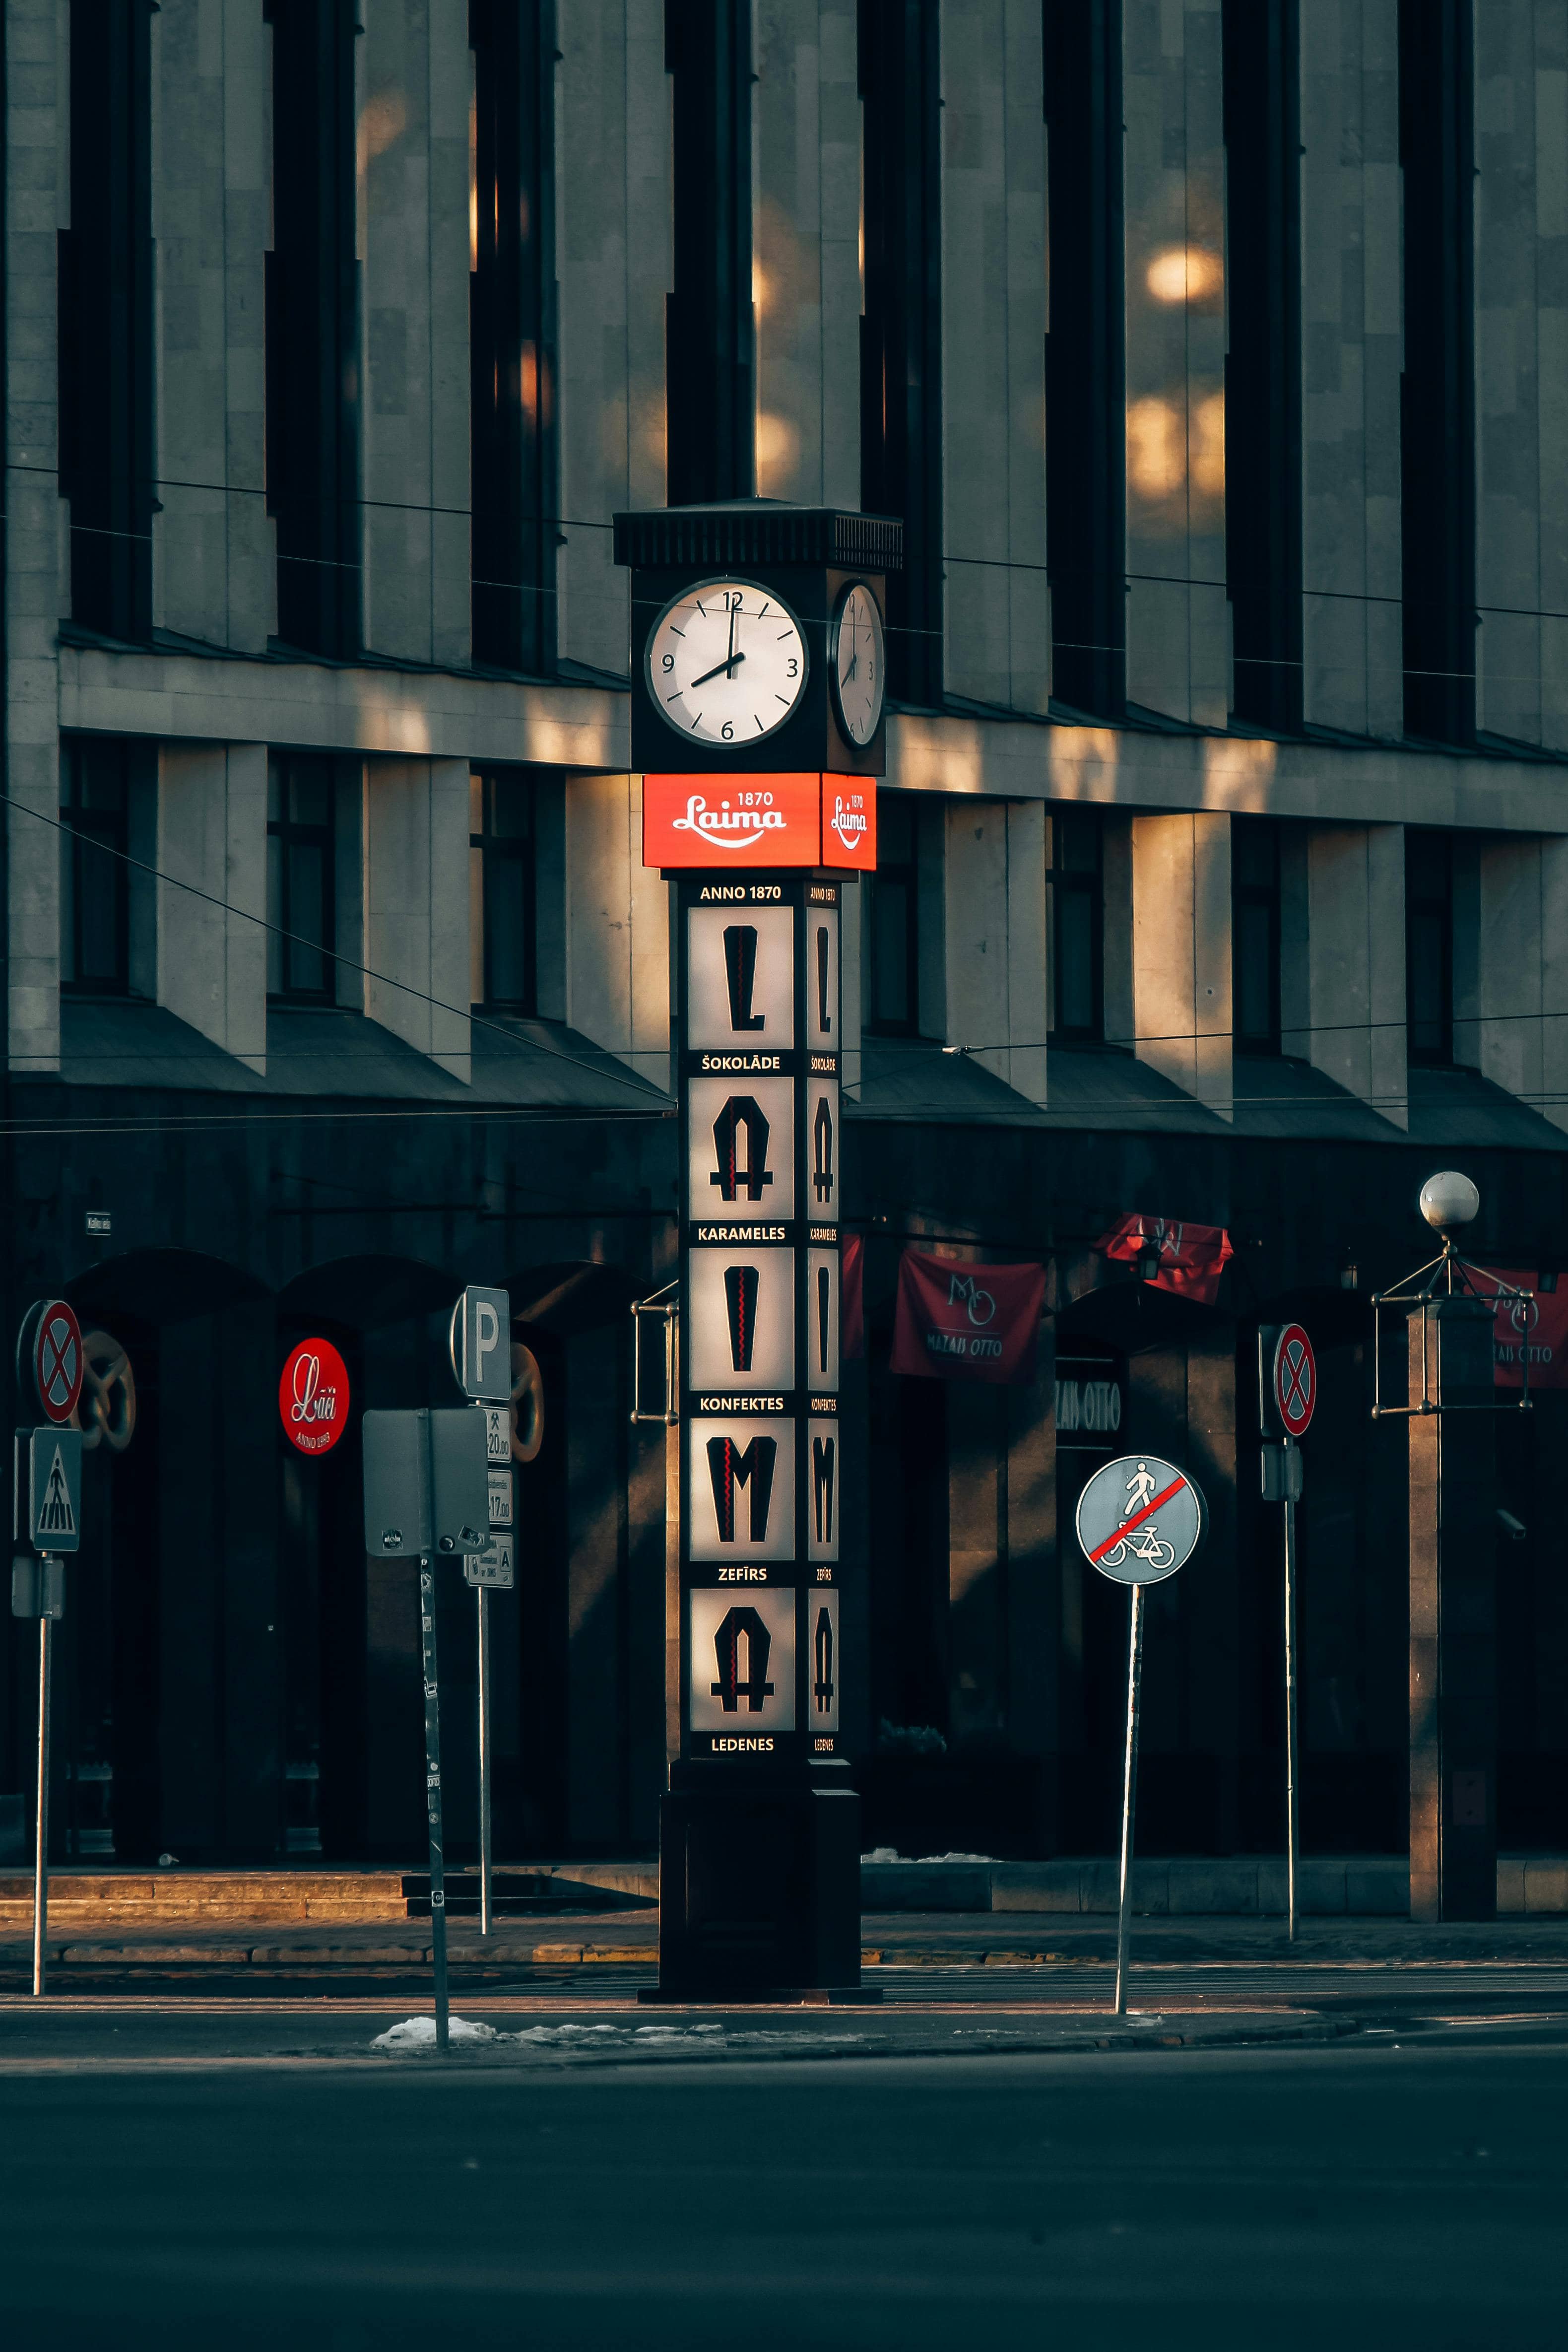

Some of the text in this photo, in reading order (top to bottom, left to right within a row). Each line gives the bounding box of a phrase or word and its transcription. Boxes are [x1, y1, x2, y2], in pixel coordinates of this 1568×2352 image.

[722, 592, 743, 610] 12
[662, 654, 675, 673] 9
[786, 658, 798, 677] 3
[869, 661, 873, 680] 3
[721, 721, 734, 740] 6
[738, 792, 773, 806] 1870
[851, 795, 863, 808] 1870
[672, 793, 787, 848] Laima
[831, 796, 867, 850] Laima
[700, 886, 781, 899] ANNO 1870
[810, 887, 835, 901] ANNO 1870
[702, 1054, 780, 1070] ŠOKOLĀDE
[811, 1055, 836, 1071] ŠOKOLĀDE
[698, 1227, 785, 1240] KARAMELES
[810, 1228, 837, 1241] KARAMELES
[475, 1302, 499, 1382] P
[971, 1339, 1002, 1357] OTTO
[701, 1398, 784, 1411] KONFEKTES
[811, 1398, 836, 1411] KONFEKTES
[1084, 1381, 1121, 1431] OTTO
[296, 1432, 316, 1449] ANNO
[502, 1550, 510, 1567] A
[718, 1566, 767, 1581] ZEFĪRS
[817, 1566, 832, 1581] ZEFĪRS
[712, 1739, 774, 1751] LEDENES
[815, 1739, 834, 1751] LEDENES
